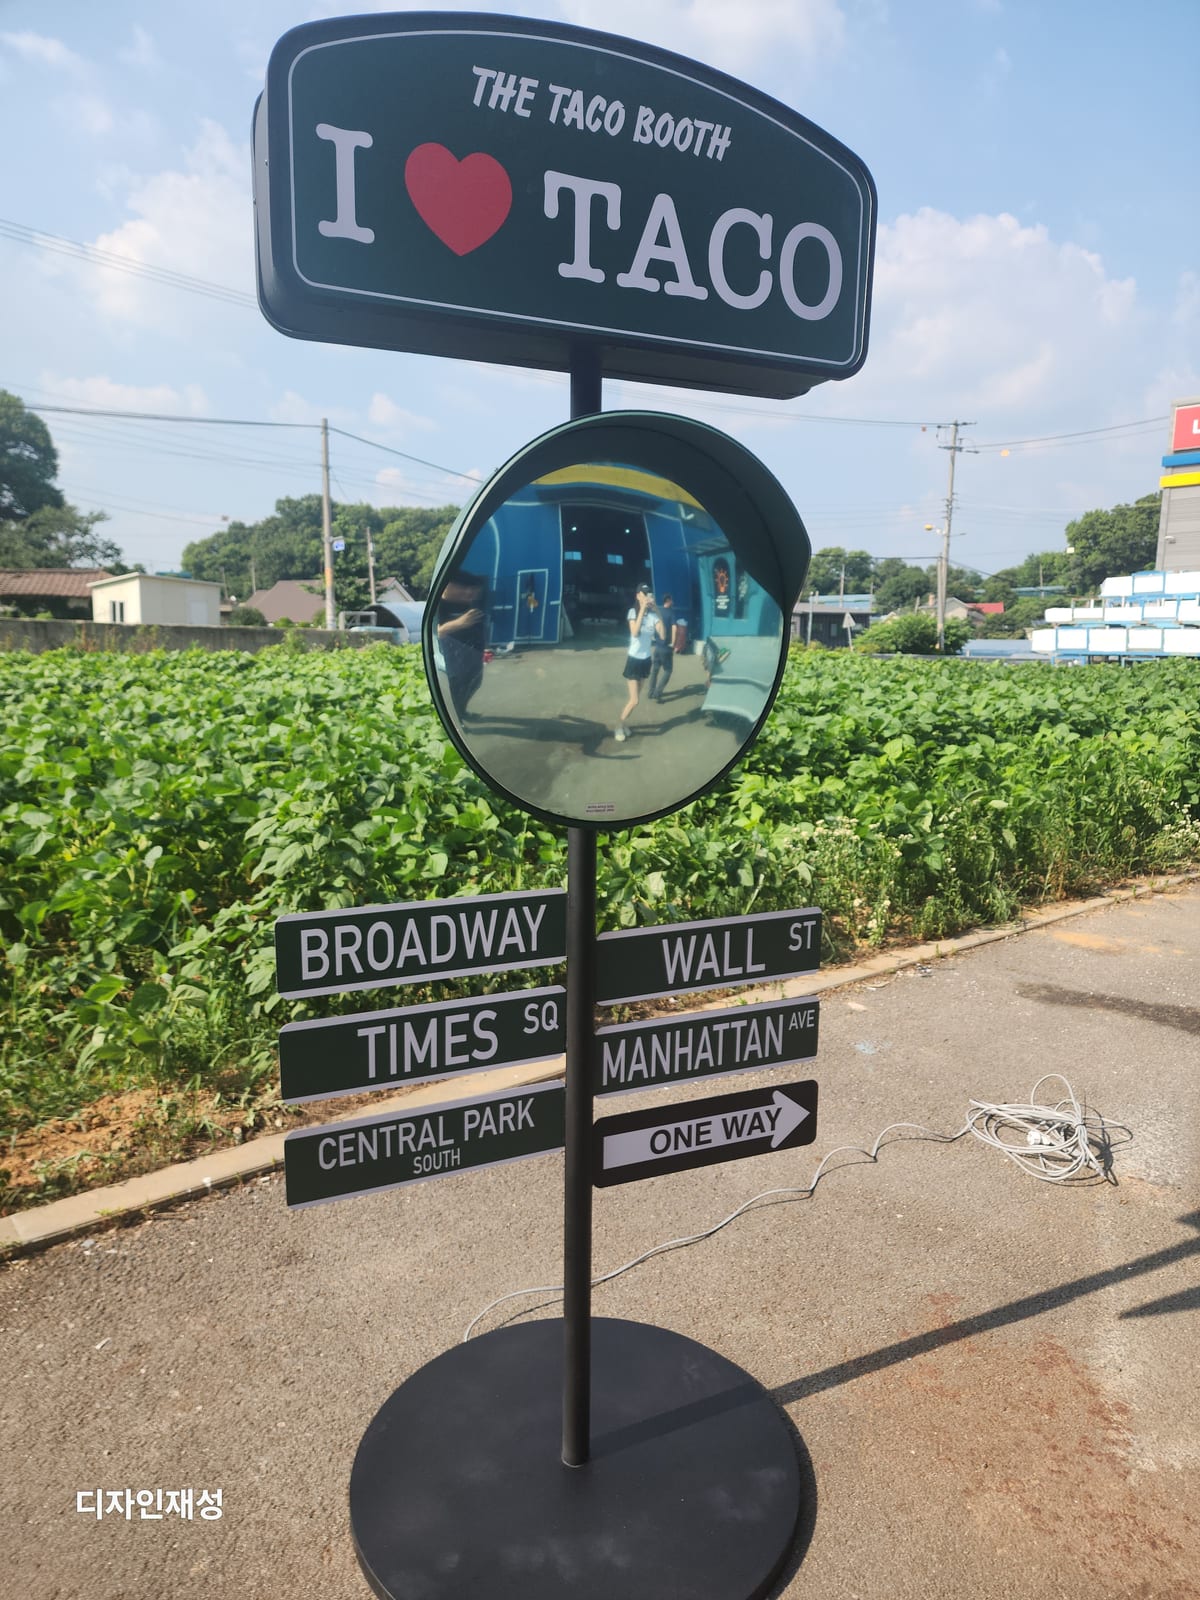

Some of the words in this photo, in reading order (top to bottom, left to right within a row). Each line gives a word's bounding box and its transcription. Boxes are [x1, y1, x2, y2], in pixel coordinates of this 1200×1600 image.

[472, 65, 539, 118] THE
[548, 84, 626, 137] TACO
[632, 105, 732, 162] BOOTH
[315, 123, 375, 244] I
[543, 169, 843, 321] TACO
[300, 904, 547, 981] BROADWAY
[662, 928, 766, 985] WALL
[788, 920, 817, 951] ST
[357, 1009, 498, 1079] TIMES
[523, 1000, 559, 1034] SQ
[601, 1014, 784, 1087] MANHATTAN
[788, 1009, 816, 1031] AVE
[318, 1115, 455, 1170] CENTRAL
[463, 1098, 536, 1142] PARK
[413, 1148, 461, 1174] SOUTH
[650, 1121, 712, 1155] ONE
[721, 1107, 783, 1140] WAY
